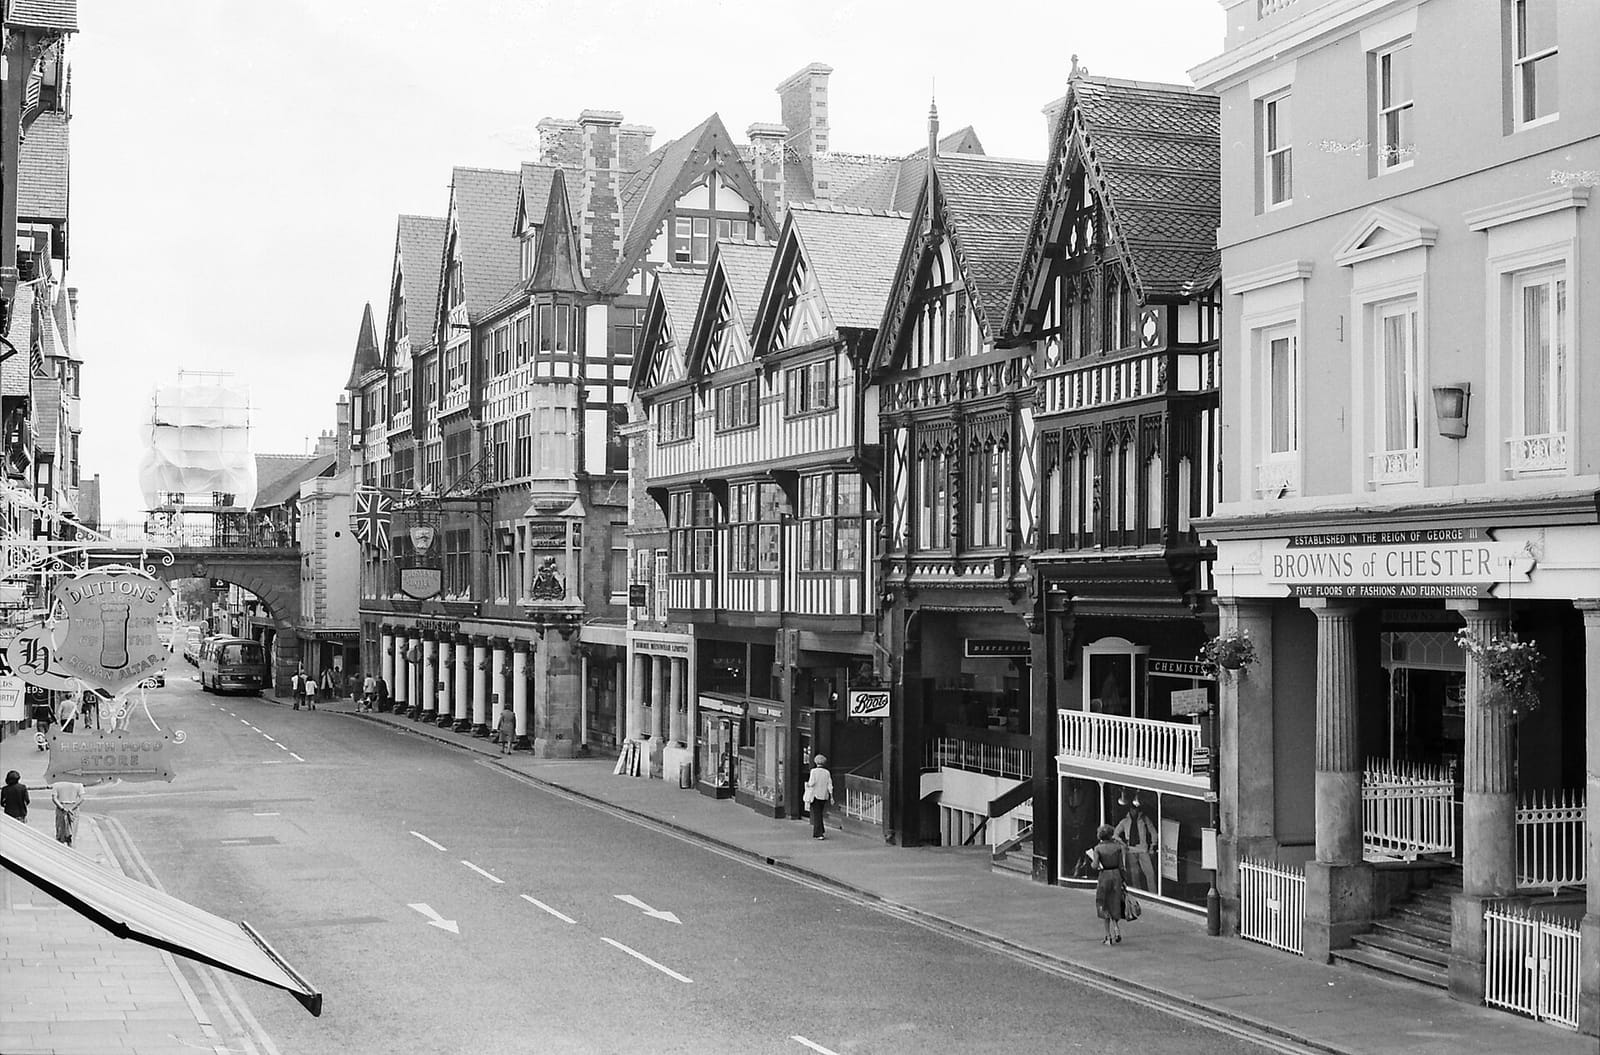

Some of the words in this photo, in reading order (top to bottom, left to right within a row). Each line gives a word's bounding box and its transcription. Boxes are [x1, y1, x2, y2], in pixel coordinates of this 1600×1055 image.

[1295, 535, 1346, 545] ESTABLISHED
[1349, 534, 1358, 544] IN
[1362, 533, 1376, 543] THE
[1381, 532, 1406, 542] REIGN
[1410, 531, 1421, 541] OF
[1427, 529, 1463, 540] GEORGE
[1469, 528, 1478, 539] III
[1273, 552, 1353, 578] BROWNS
[1362, 552, 1377, 577] of
[1386, 548, 1492, 577] CHESTER
[1296, 586, 1312, 596] FIVE
[1316, 586, 1343, 596] FLOORS
[1347, 586, 1357, 596] OF
[1360, 586, 1396, 596] FASHIONS
[1400, 586, 1417, 596] AND
[1420, 586, 1478, 596] FURNISHINGS
[69, 655, 114, 680] ROMAN
[120, 654, 160, 679] ALTAR
[852, 693, 889, 714] Boots
[60, 741, 116, 752] HEALTH
[121, 741, 163, 752] FOOD
[81, 755, 139, 766] STORE
